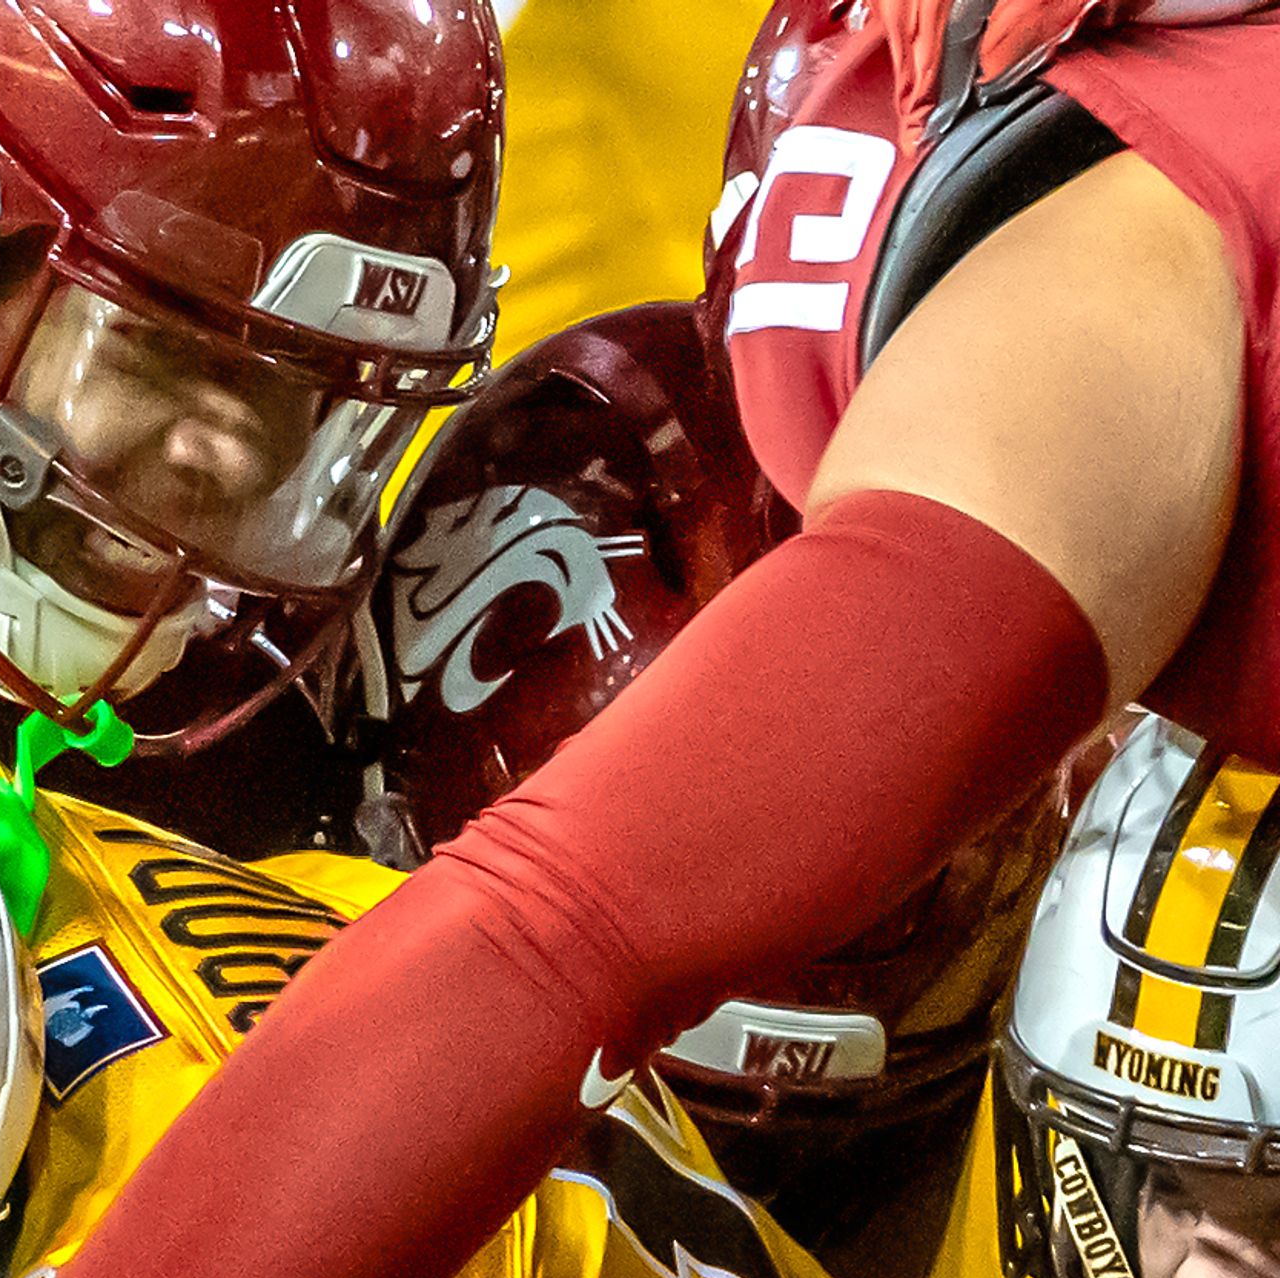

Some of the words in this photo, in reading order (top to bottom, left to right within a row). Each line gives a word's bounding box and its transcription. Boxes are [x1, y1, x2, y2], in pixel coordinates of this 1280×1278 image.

[353, 256, 430, 317] WSU
[743, 1030, 837, 1077] WSU
[1094, 1031, 1221, 1101] WYOMING
